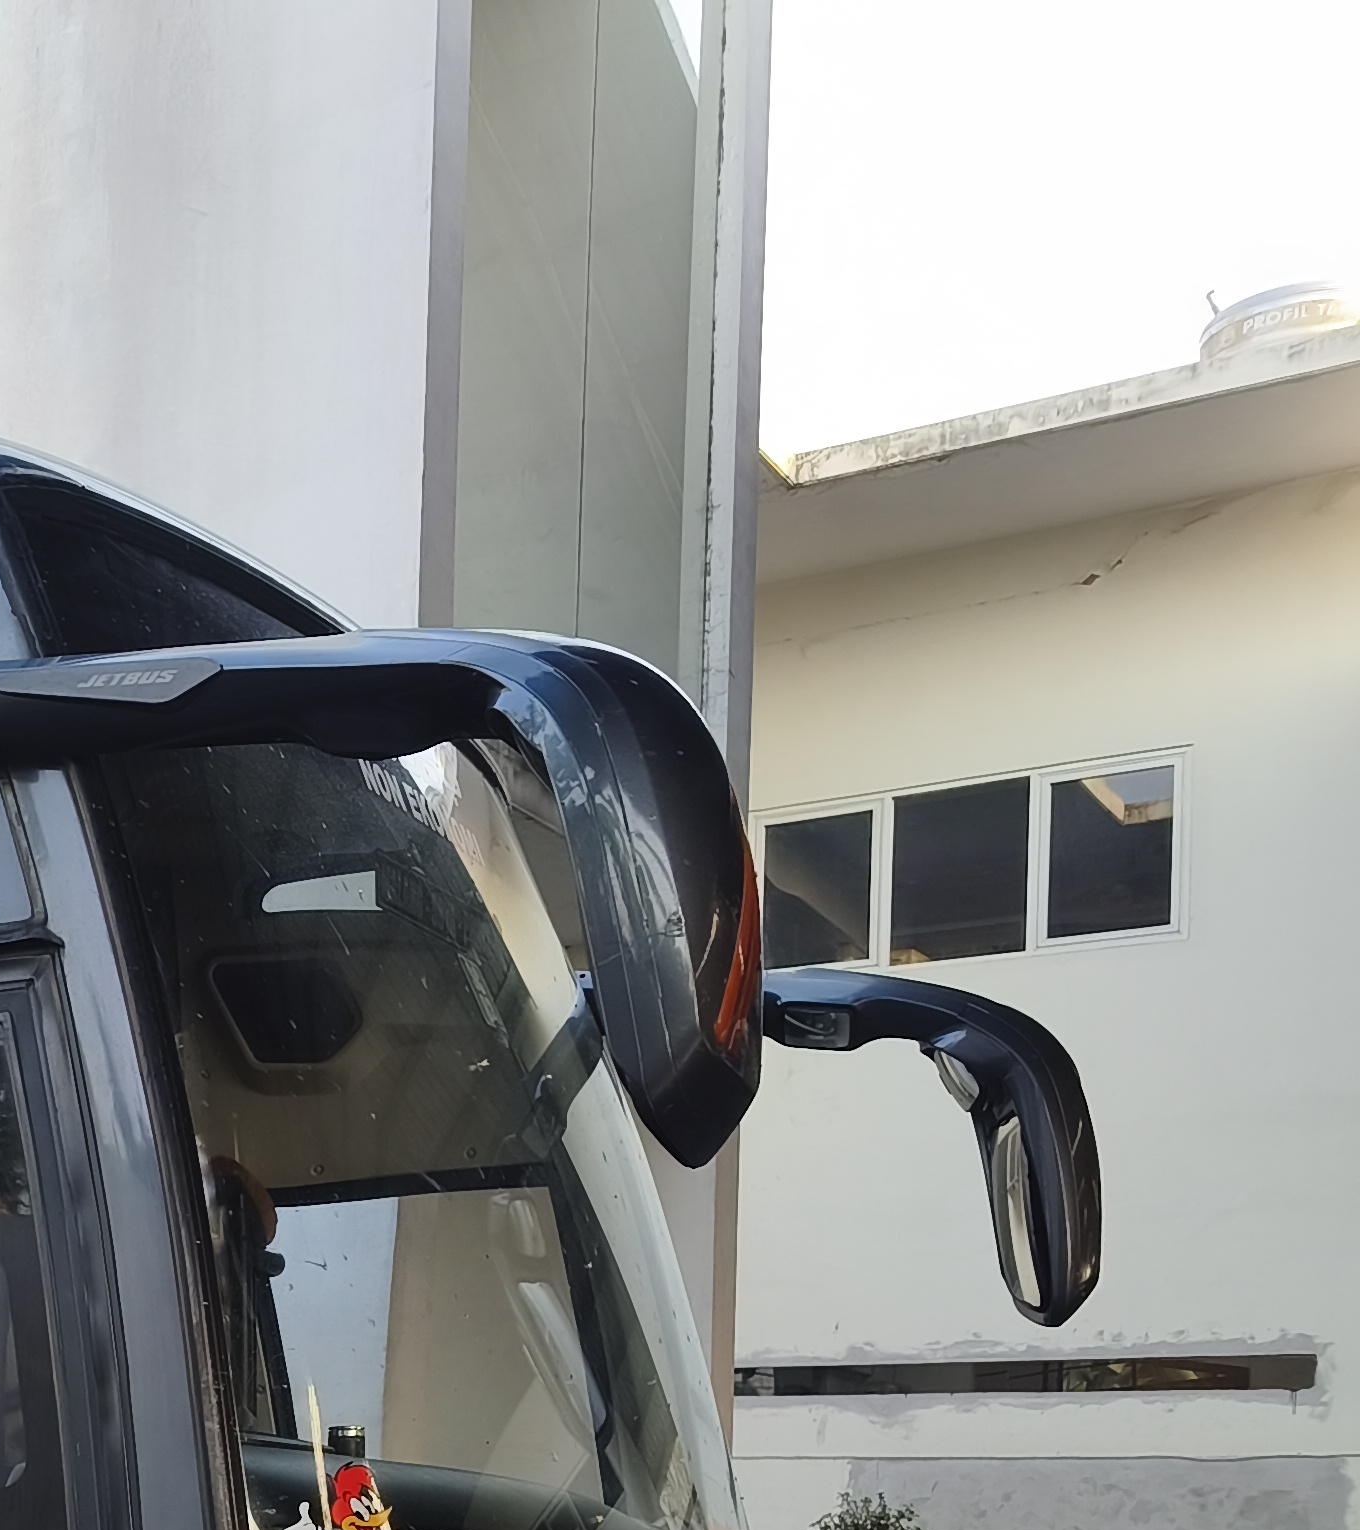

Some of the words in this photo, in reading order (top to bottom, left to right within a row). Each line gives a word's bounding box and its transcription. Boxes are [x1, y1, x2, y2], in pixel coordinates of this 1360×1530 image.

[1242, 303, 1309, 334] PROFIL
[77, 669, 178, 688] JETBUS
[357, 757, 408, 812] NON
